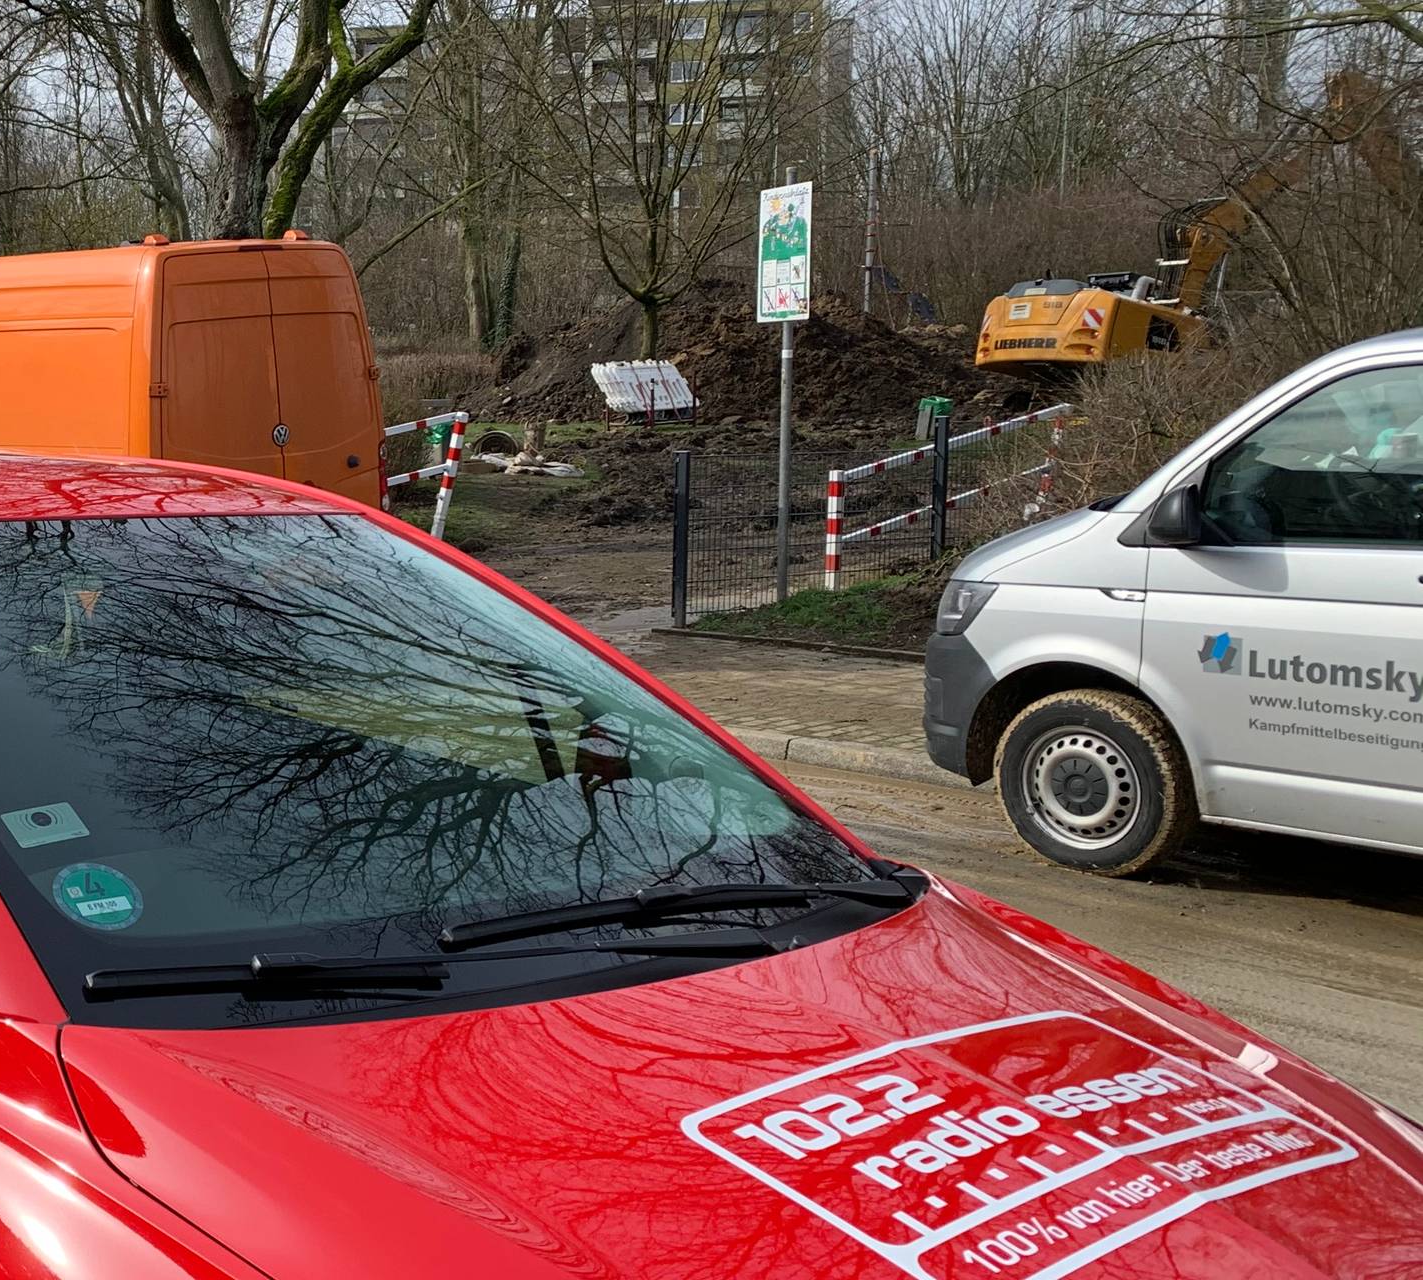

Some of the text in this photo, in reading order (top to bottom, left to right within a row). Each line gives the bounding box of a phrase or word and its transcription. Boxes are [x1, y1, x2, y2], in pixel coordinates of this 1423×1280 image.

[994, 337, 1058, 350] LIEBHERR
[1248, 650, 1423, 702] Lutomsky
[84, 872, 106, 897] 4
[733, 1074, 945, 1160] 102.2
[853, 1067, 1199, 1190] radio essen
[963, 1216, 1069, 1273] 100%
[1057, 1185, 1118, 1231] von
[1106, 1169, 1172, 1209] hier.
[1152, 1160, 1211, 1182] Der
[1193, 1143, 1272, 1170] beste
